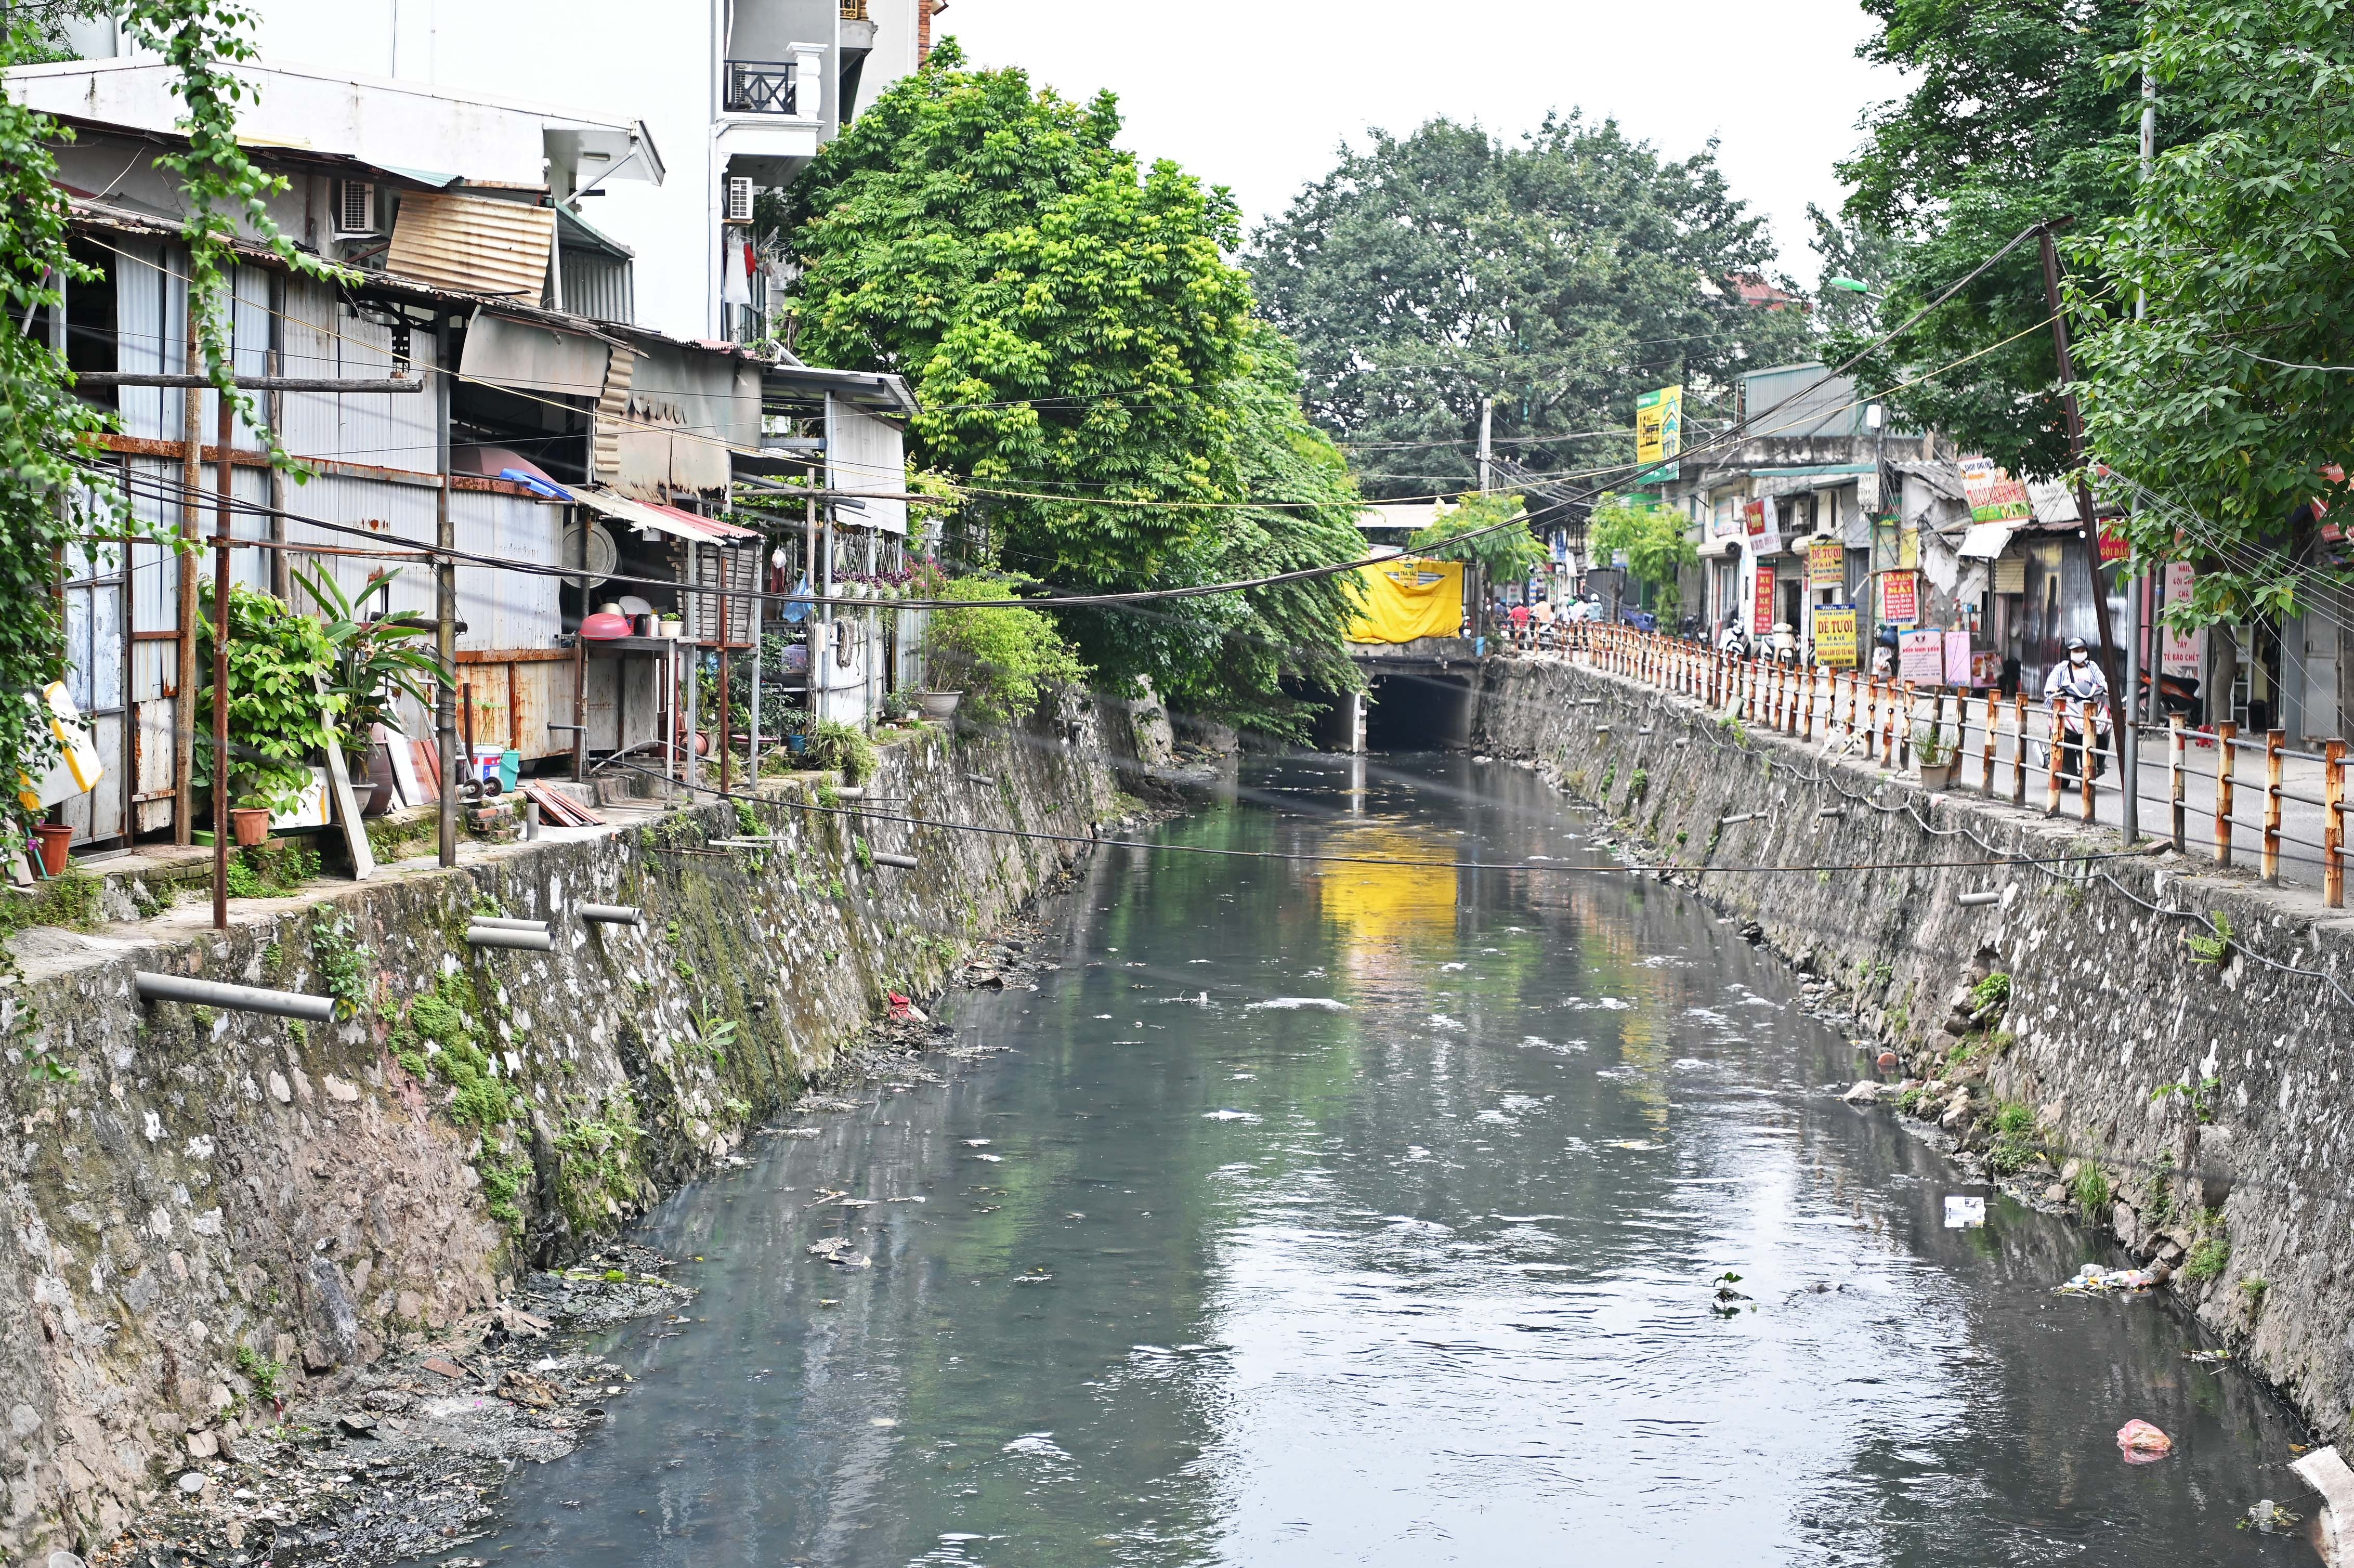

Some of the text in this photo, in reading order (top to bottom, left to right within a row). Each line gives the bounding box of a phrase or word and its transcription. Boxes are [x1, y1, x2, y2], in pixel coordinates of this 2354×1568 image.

[1965, 463, 1976, 472] SHOP
[2101, 545, 2113, 558] GỘI
[1759, 576, 1771, 584] XE
[1818, 617, 1853, 634] DÊ TƯƠI
[2164, 650, 2170, 661] TẾ
[2185, 650, 2200, 662] CHẾT
